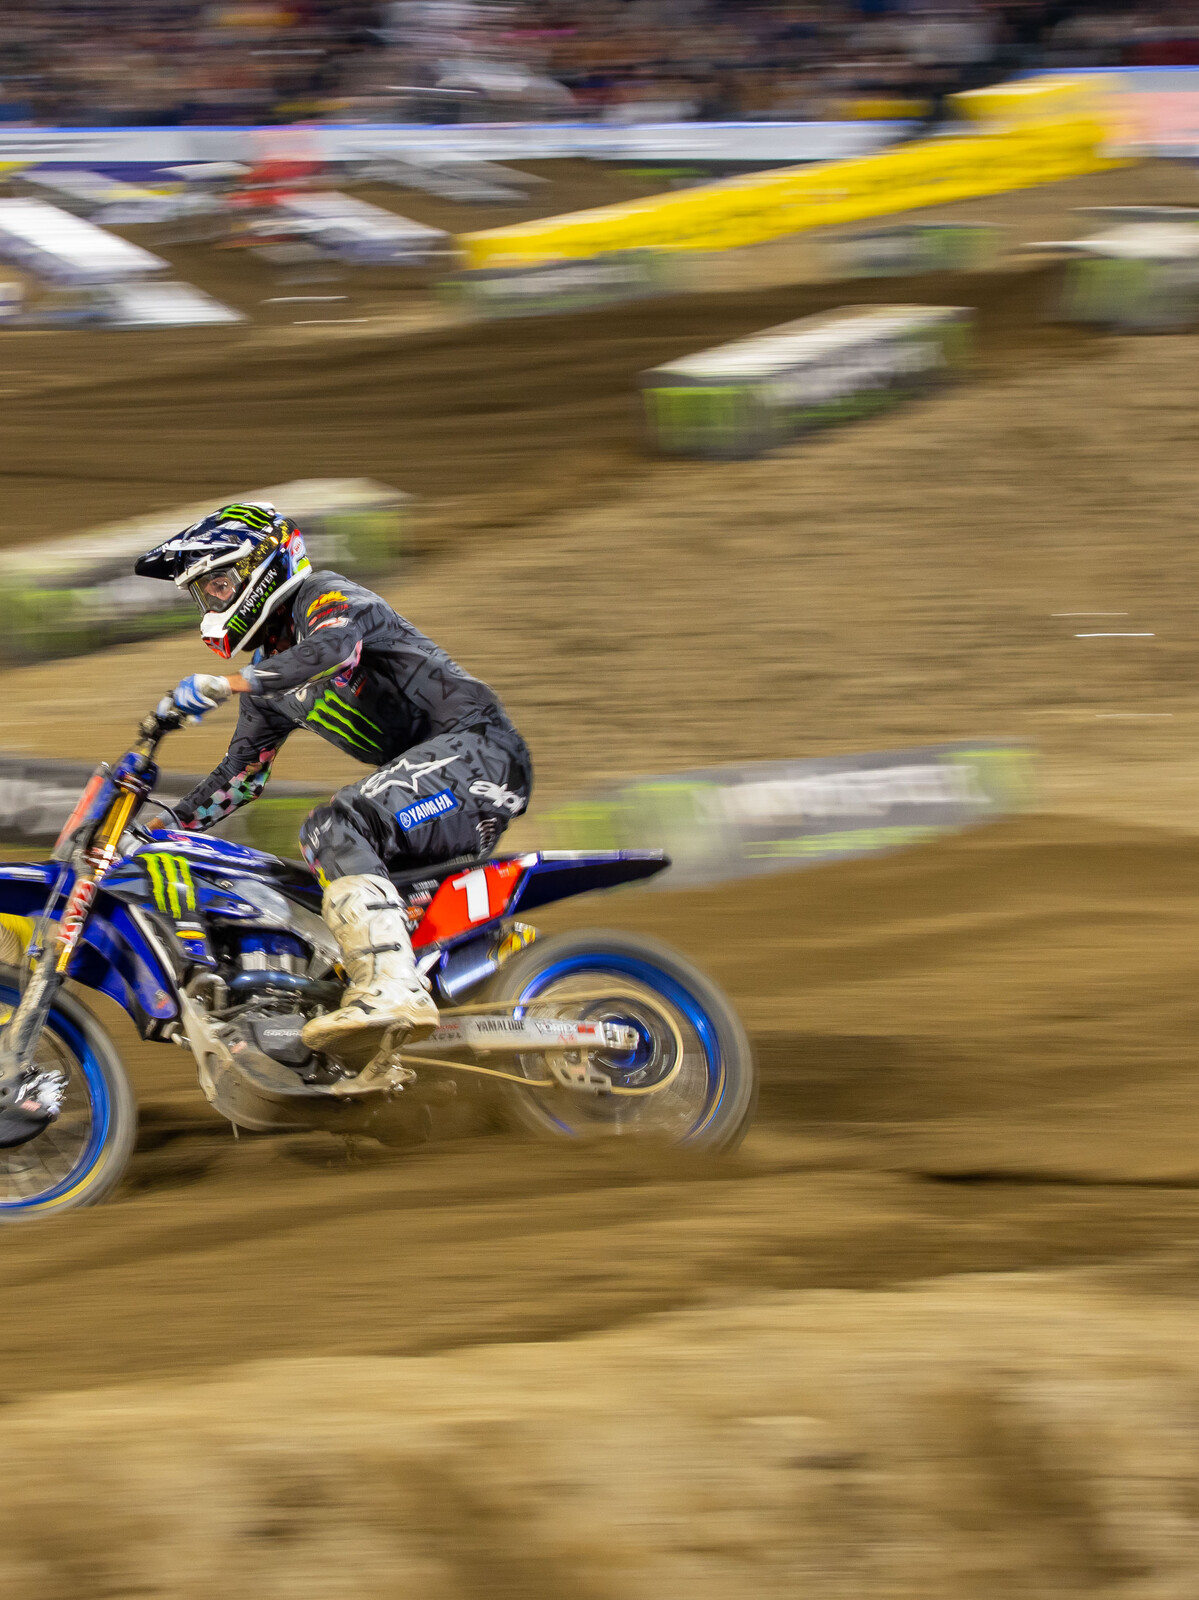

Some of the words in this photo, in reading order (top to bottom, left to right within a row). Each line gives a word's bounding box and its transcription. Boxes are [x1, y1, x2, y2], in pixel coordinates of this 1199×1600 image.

[239, 568, 279, 617] MONSTER
[251, 580, 277, 614] ENERGY
[407, 793, 455, 823] YAMAHA
[452, 868, 490, 923] 1
[475, 1019, 525, 1033] YAMALUBE
